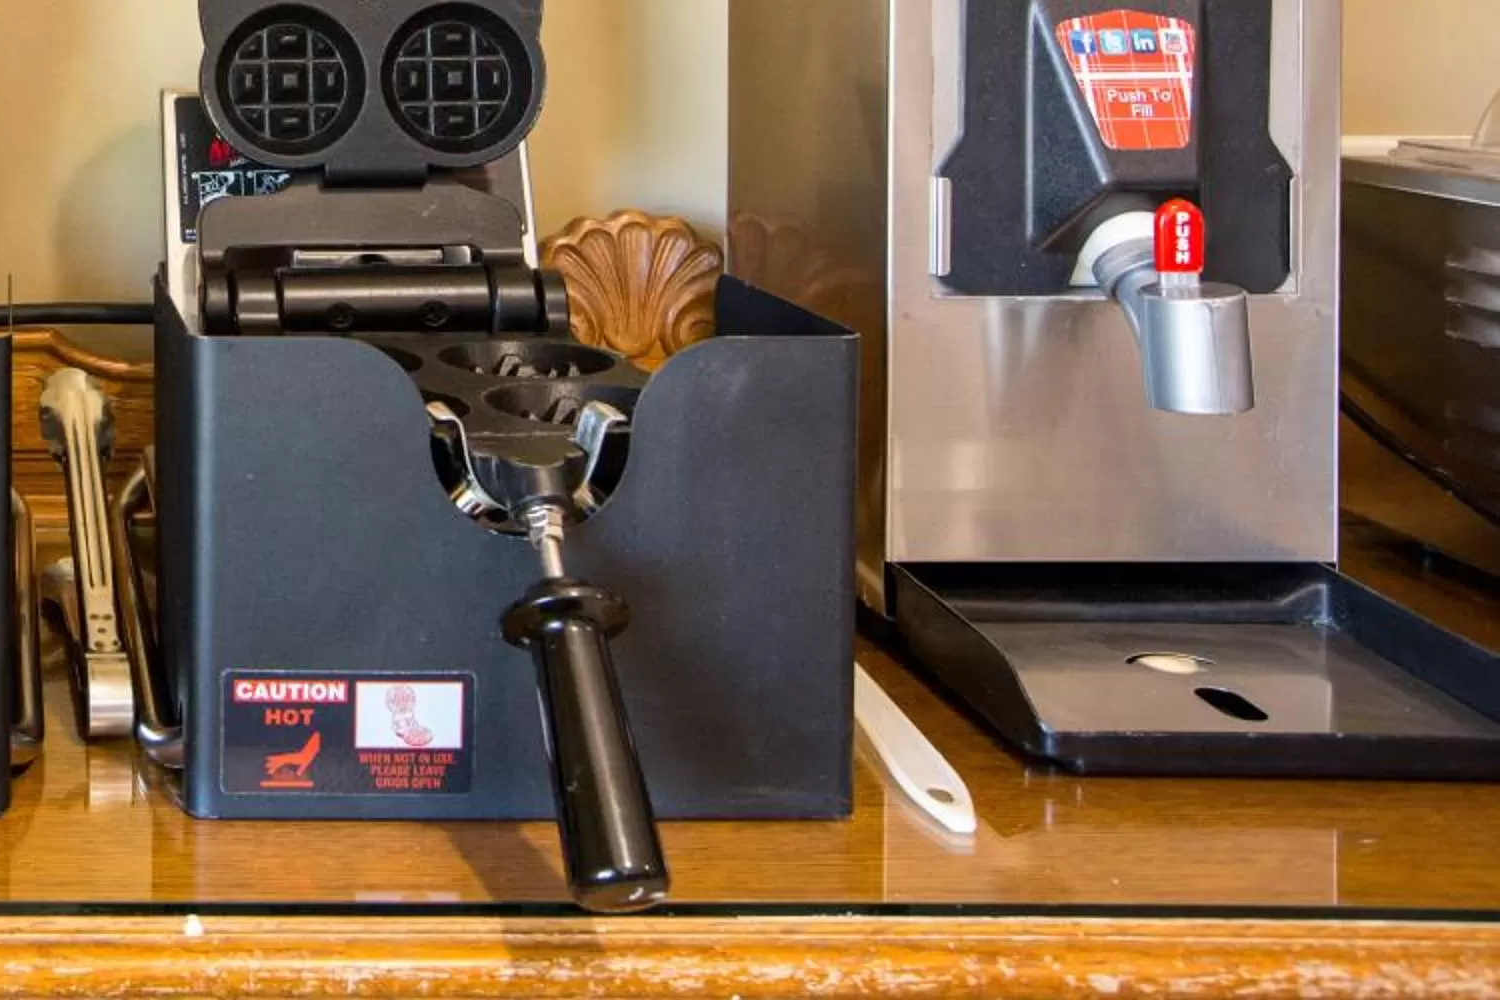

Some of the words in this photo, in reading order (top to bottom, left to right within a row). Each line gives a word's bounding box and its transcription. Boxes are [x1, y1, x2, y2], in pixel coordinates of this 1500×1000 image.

[1107, 89, 1147, 103] Push
[1150, 88, 1172, 103] To
[1131, 103, 1154, 118] Fill
[1175, 211, 1190, 265] PUSH
[235, 682, 346, 700] CAUTION
[265, 709, 315, 725] HOT
[371, 765, 409, 776] PLEASE
[413, 765, 445, 776] LEAVE
[412, 777, 441, 789] OPEN
